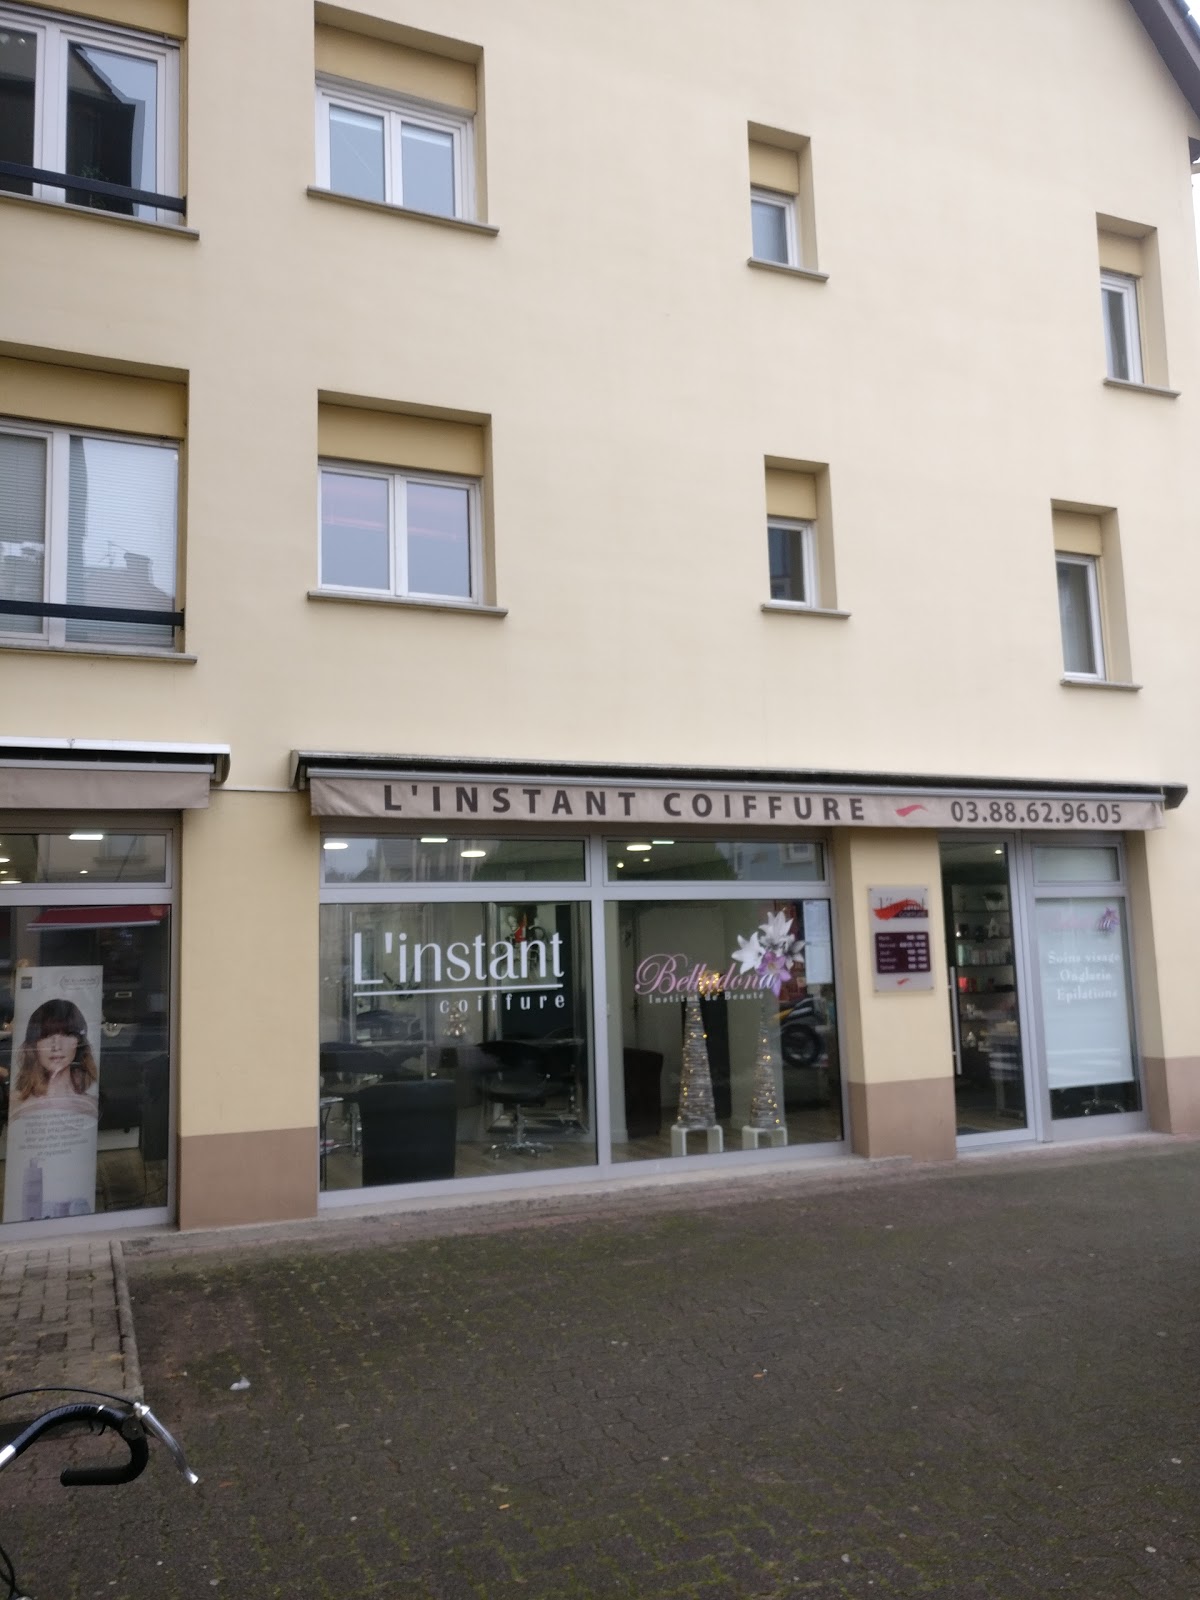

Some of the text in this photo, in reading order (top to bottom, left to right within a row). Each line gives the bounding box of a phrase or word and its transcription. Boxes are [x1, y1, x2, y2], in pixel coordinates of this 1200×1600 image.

[383, 784, 865, 821] L'INSTANT COIFFURE
[950, 801, 1122, 824] 03.88.62.96.05
[353, 932, 565, 985] L'instant
[439, 993, 566, 1014] coiffure
